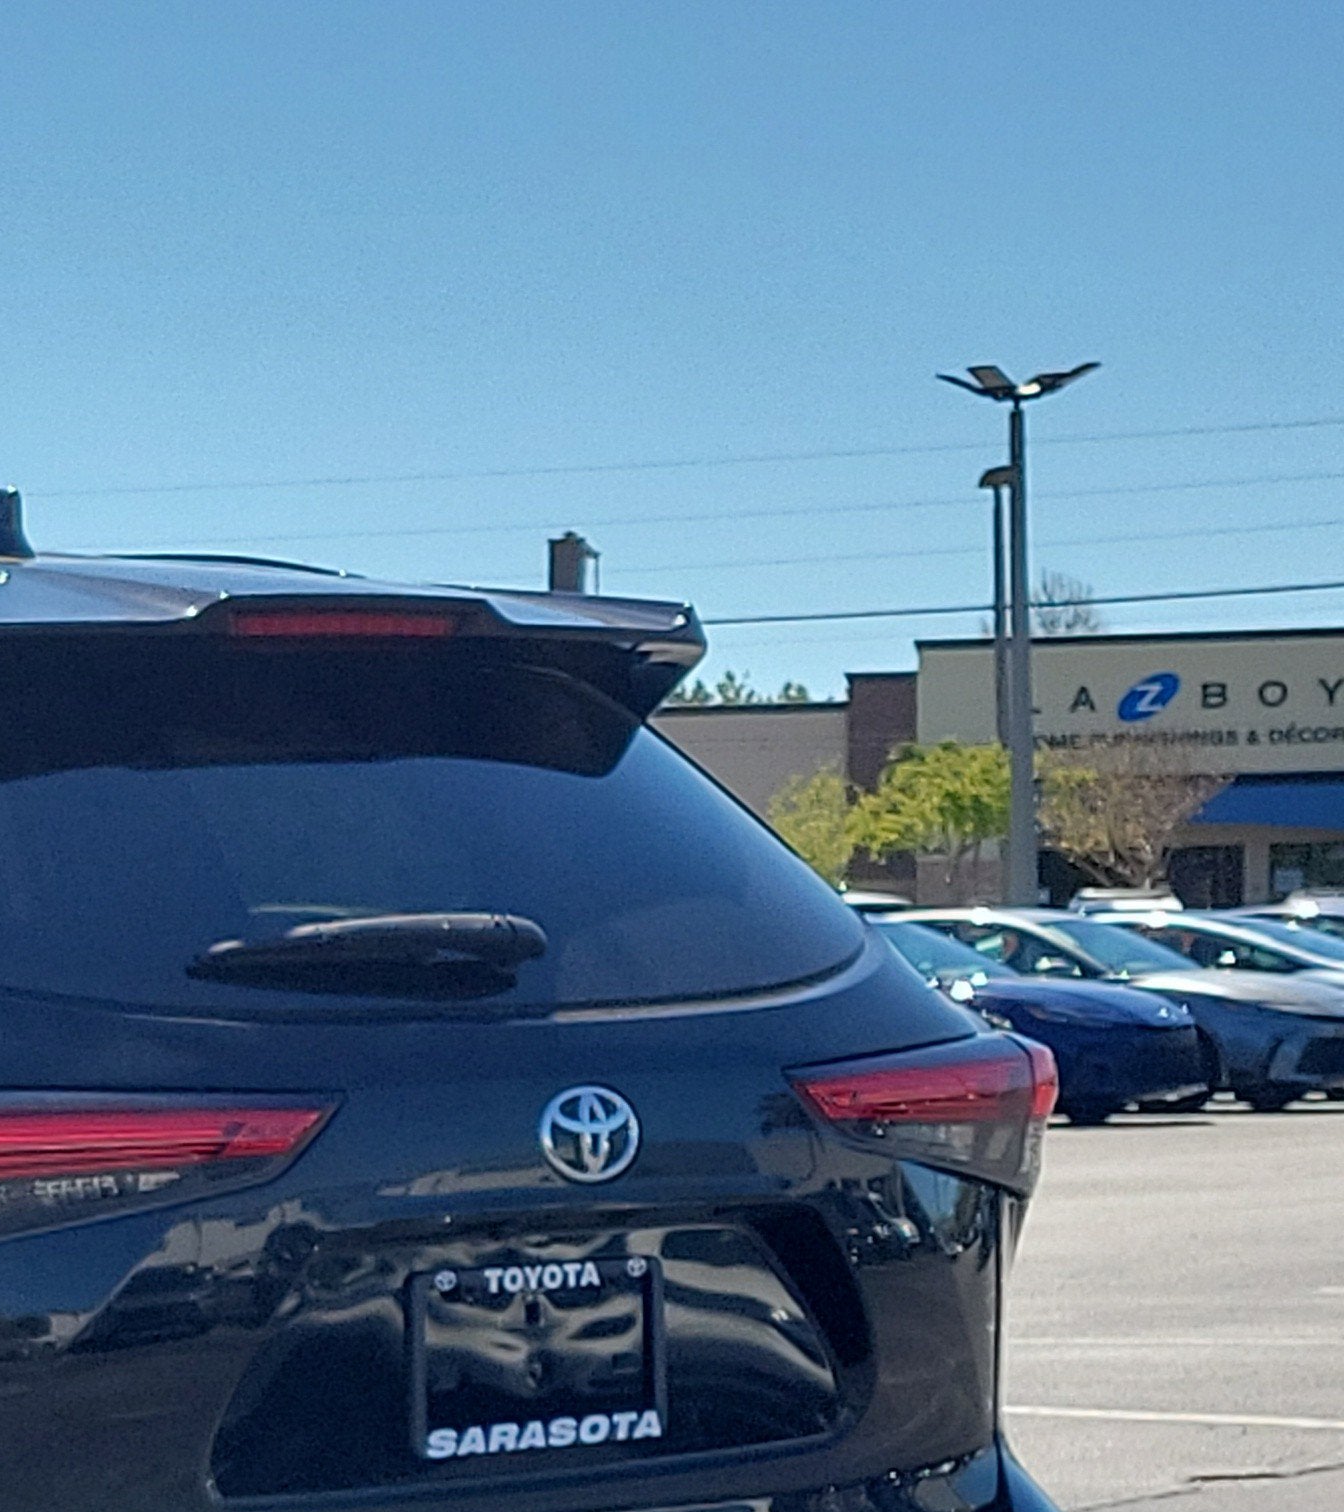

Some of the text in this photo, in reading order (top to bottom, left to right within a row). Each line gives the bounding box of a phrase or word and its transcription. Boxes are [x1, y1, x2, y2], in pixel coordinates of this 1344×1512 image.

[1033, 733, 1081, 751] OME
[484, 1261, 601, 1294] TOYOTA
[427, 1410, 662, 1459] SARASOTA
